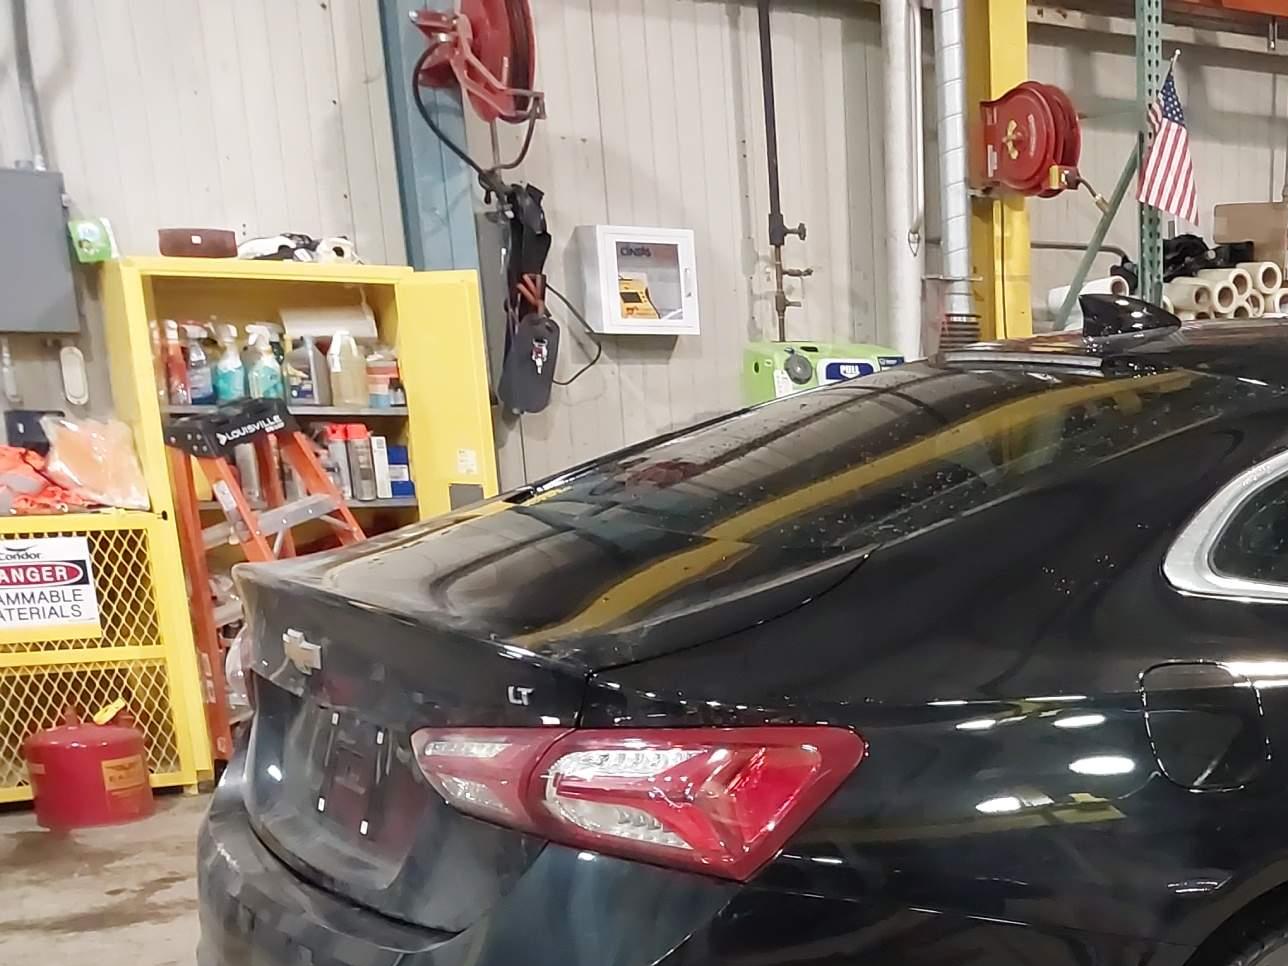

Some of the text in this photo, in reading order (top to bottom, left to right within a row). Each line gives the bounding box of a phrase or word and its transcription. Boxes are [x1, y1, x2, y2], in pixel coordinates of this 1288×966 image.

[225, 414, 283, 440] LOUISVILLE
[0, 565, 68, 584] ANGER
[508, 686, 534, 706] LT
